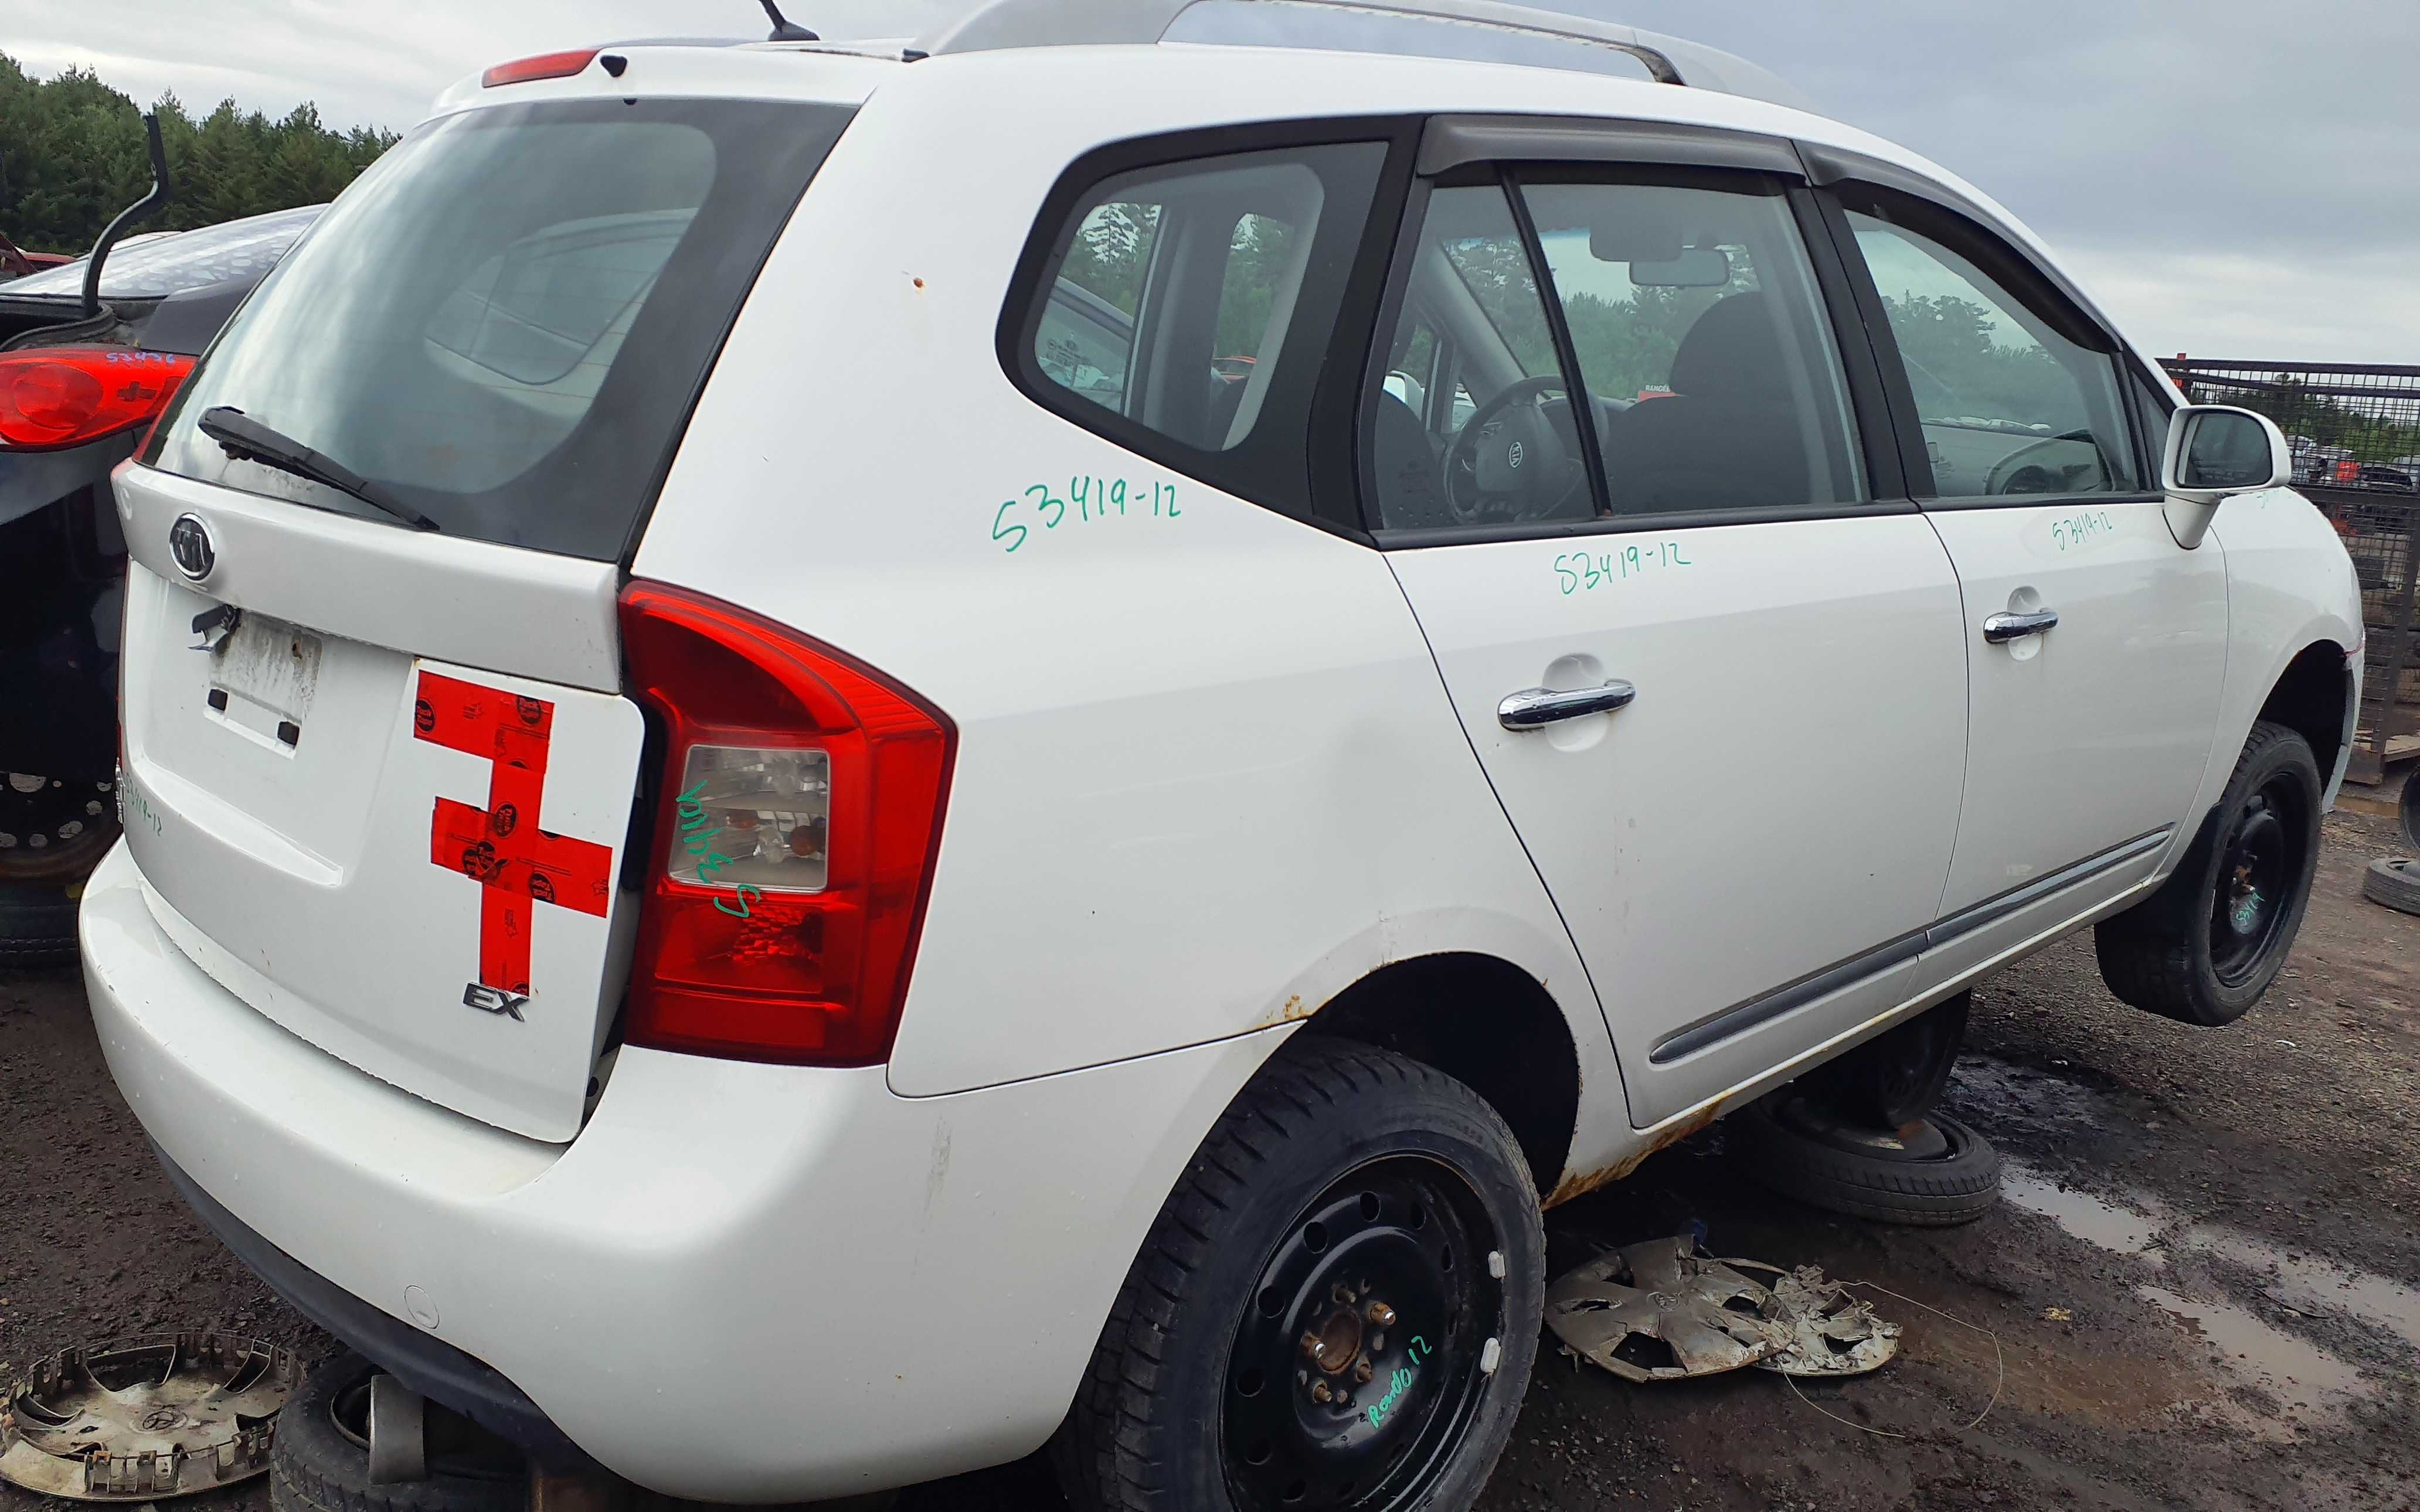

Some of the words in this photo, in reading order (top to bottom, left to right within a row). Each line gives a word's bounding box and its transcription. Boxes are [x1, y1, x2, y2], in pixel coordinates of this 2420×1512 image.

[992, 475, 1181, 553] 53419-12
[2052, 511, 2113, 551] 53419-12
[1554, 542, 1692, 595] 53419-12
[675, 779, 761, 918] 53419
[463, 981, 530, 1023] EX
[1408, 1335, 1432, 1365] 12
